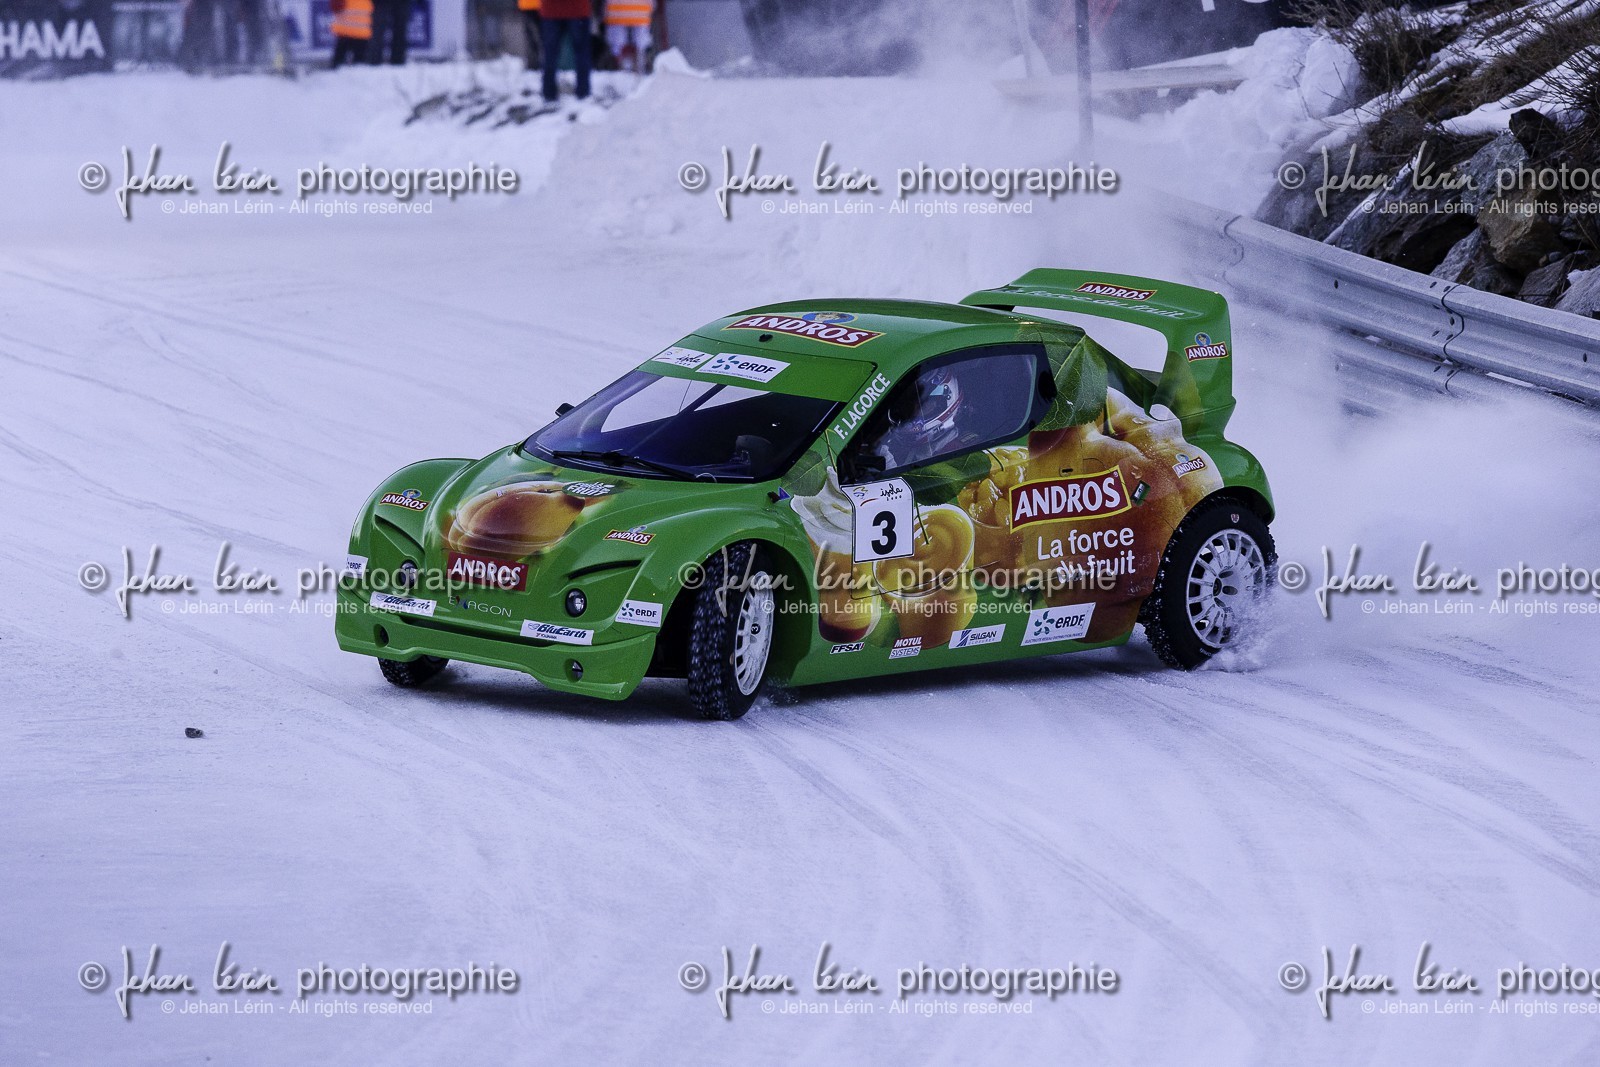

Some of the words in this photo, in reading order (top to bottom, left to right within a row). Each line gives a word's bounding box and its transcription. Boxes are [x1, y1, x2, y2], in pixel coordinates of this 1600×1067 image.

[0, 19, 105, 59] HAMA
[1081, 284, 1150, 301] ANDROS
[735, 316, 866, 344] ANDROS
[1188, 343, 1226, 359] ANDROS
[738, 361, 777, 374] eRDF
[833, 423, 849, 440] F.
[842, 372, 891, 429] LAGORCE
[1175, 458, 1205, 475] ANDROS
[381, 494, 427, 510] ANDROS
[1014, 476, 1121, 522] ANDROS
[608, 531, 650, 544] ANDROS
[871, 510, 897, 555] 3
[1037, 535, 1064, 561] La
[1068, 527, 1135, 555] force
[451, 557, 522, 586] ANDROS
[1056, 560, 1084, 584] du
[1087, 550, 1136, 580] fruit
[635, 608, 657, 618] eRDF
[1055, 613, 1086, 629] eRDF
[537, 623, 587, 639] BluEarth
[969, 630, 997, 641] SILGAN
[831, 643, 861, 654] FFSA
[894, 637, 922, 648] MOTUL
[891, 647, 920, 658] SYSTEMS
